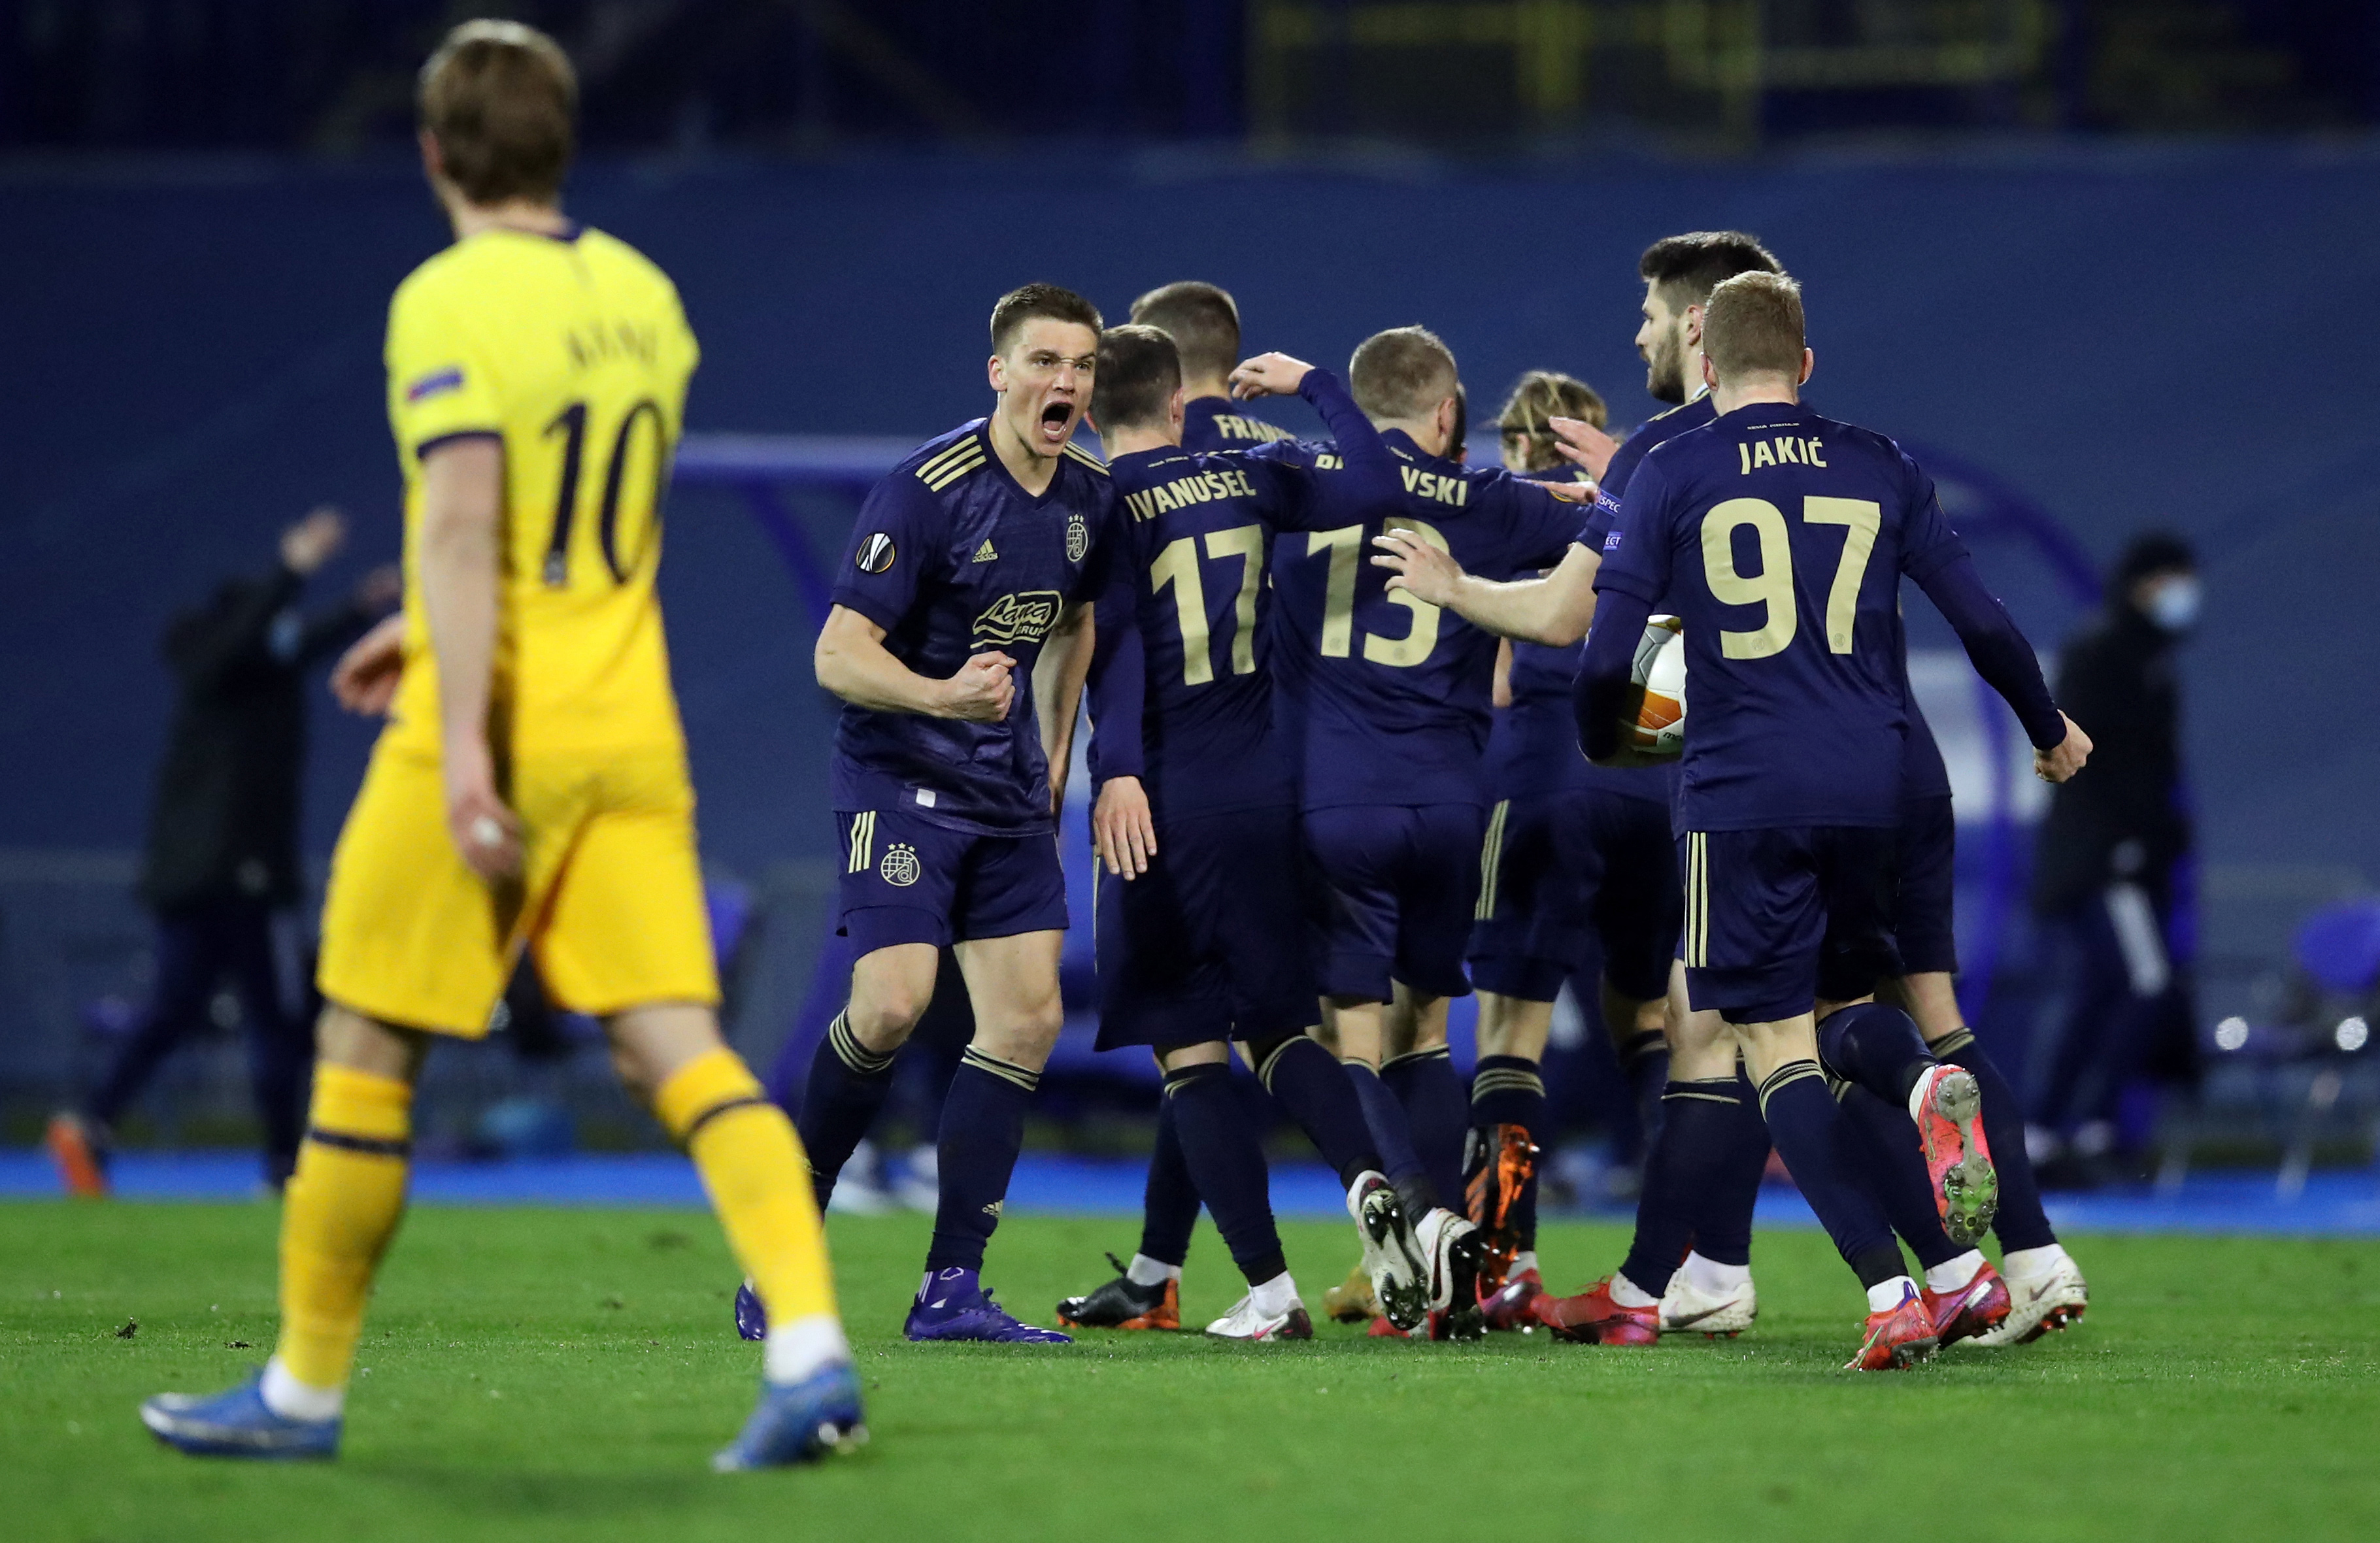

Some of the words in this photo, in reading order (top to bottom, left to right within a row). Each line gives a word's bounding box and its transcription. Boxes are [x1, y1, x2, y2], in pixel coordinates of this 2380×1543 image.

[1212, 414, 1298, 443] FRAN
[1738, 437, 1828, 475] JAKIĆ
[543, 400, 663, 584] 10
[1124, 469, 1257, 523] IVANUŠEC
[1400, 465, 1468, 506] VSKI
[1599, 495, 1621, 513] SPEC
[972, 552, 998, 563] adidas
[1700, 495, 1881, 660] 97
[1150, 524, 1264, 686] 17
[1307, 516, 1450, 668] 13
[1662, 731, 1684, 742] mo
